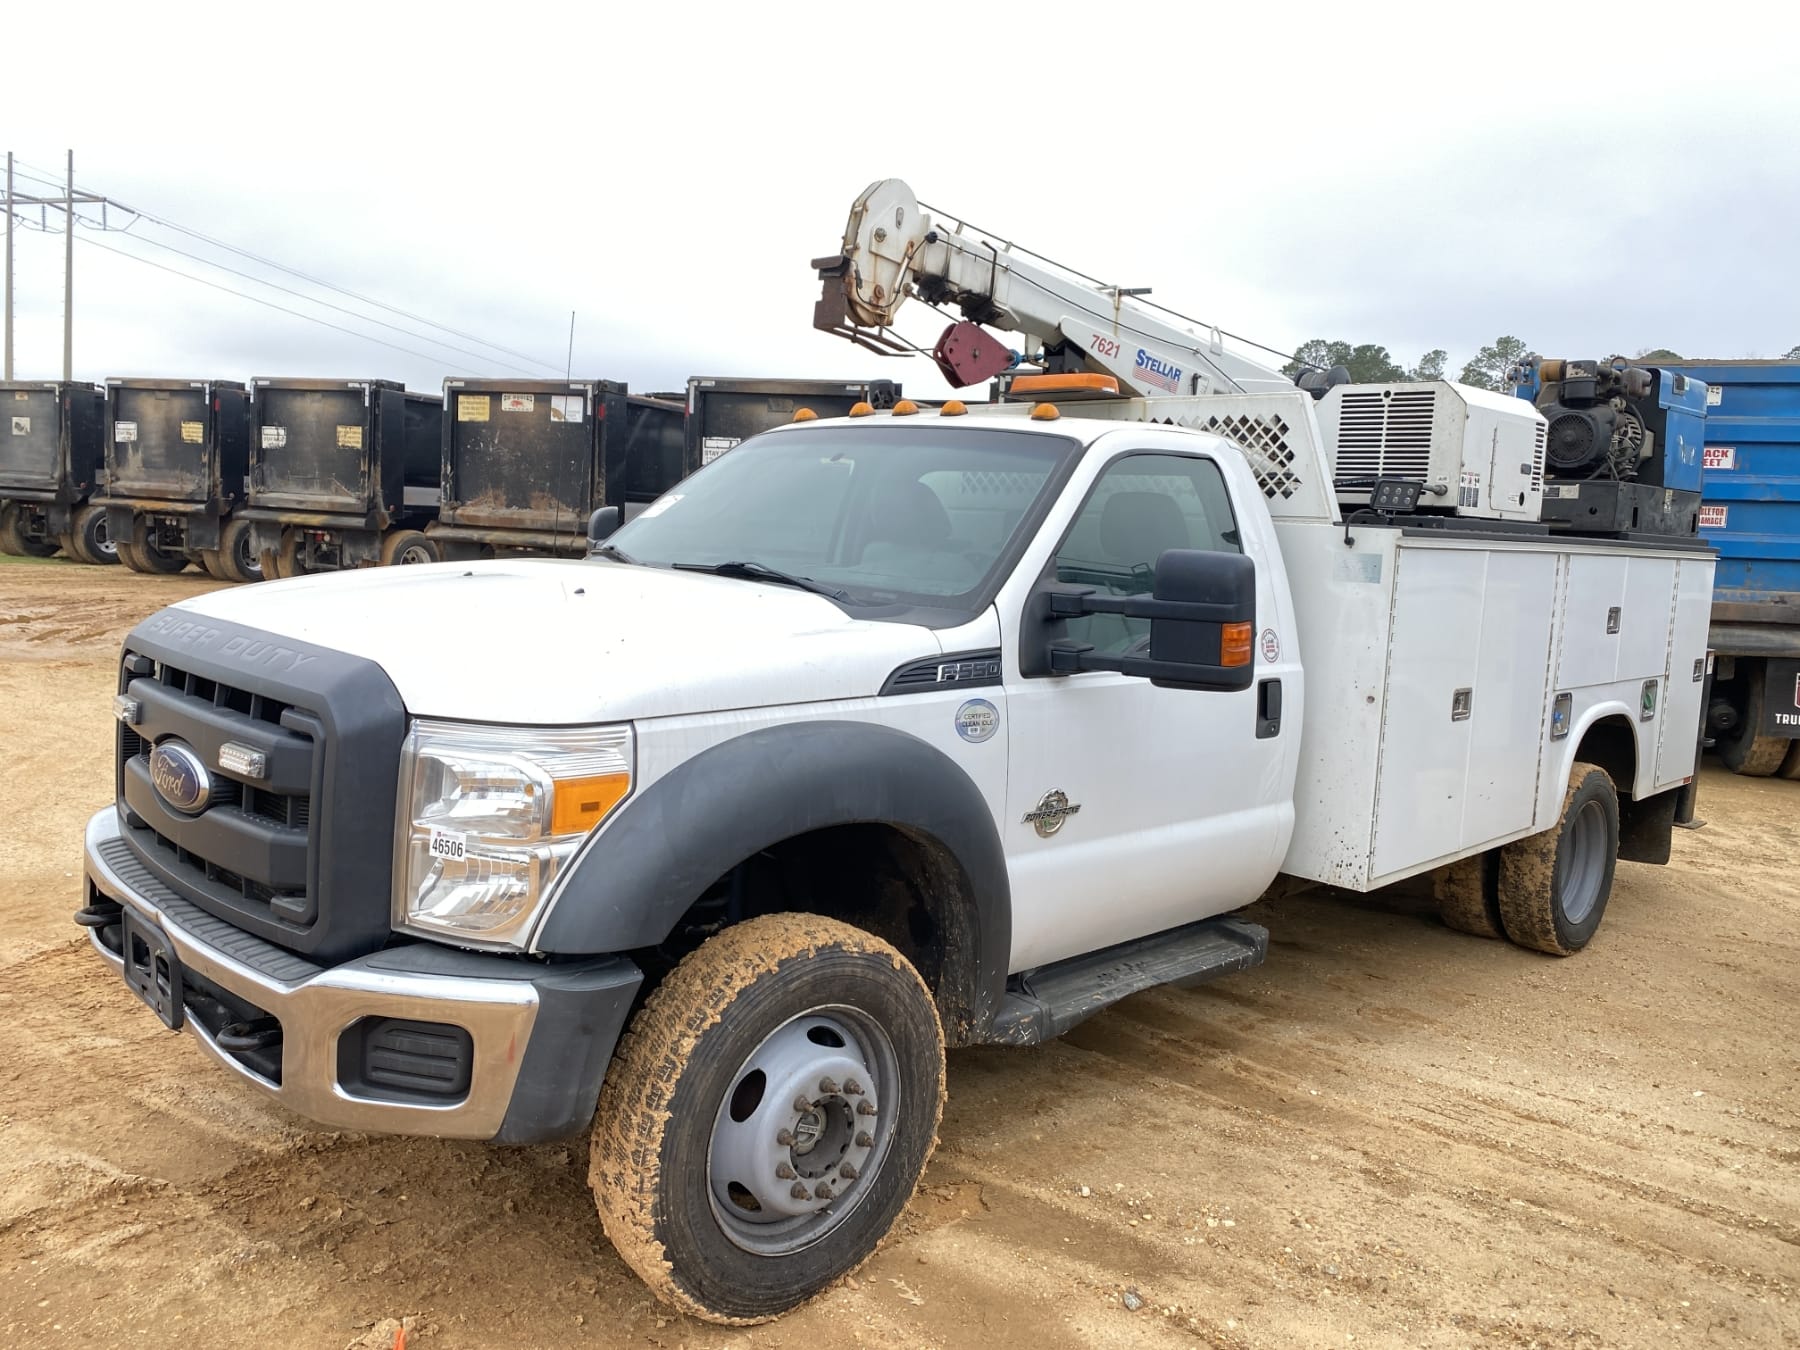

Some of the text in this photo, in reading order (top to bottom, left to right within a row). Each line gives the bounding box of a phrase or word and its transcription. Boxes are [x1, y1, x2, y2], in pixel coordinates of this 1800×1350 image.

[1090, 334, 1121, 359] 7621
[1135, 349, 1182, 382] STELLAR
[1704, 449, 1729, 458] ACK
[1712, 507, 1725, 516] FOR
[151, 615, 319, 672] SUPER DUTY
[962, 720, 981, 728] CLEAN
[964, 712, 991, 720] CERTIFIED
[1775, 713, 1800, 725] TRU
[154, 754, 186, 797] Ford
[432, 838, 464, 858] 46506
